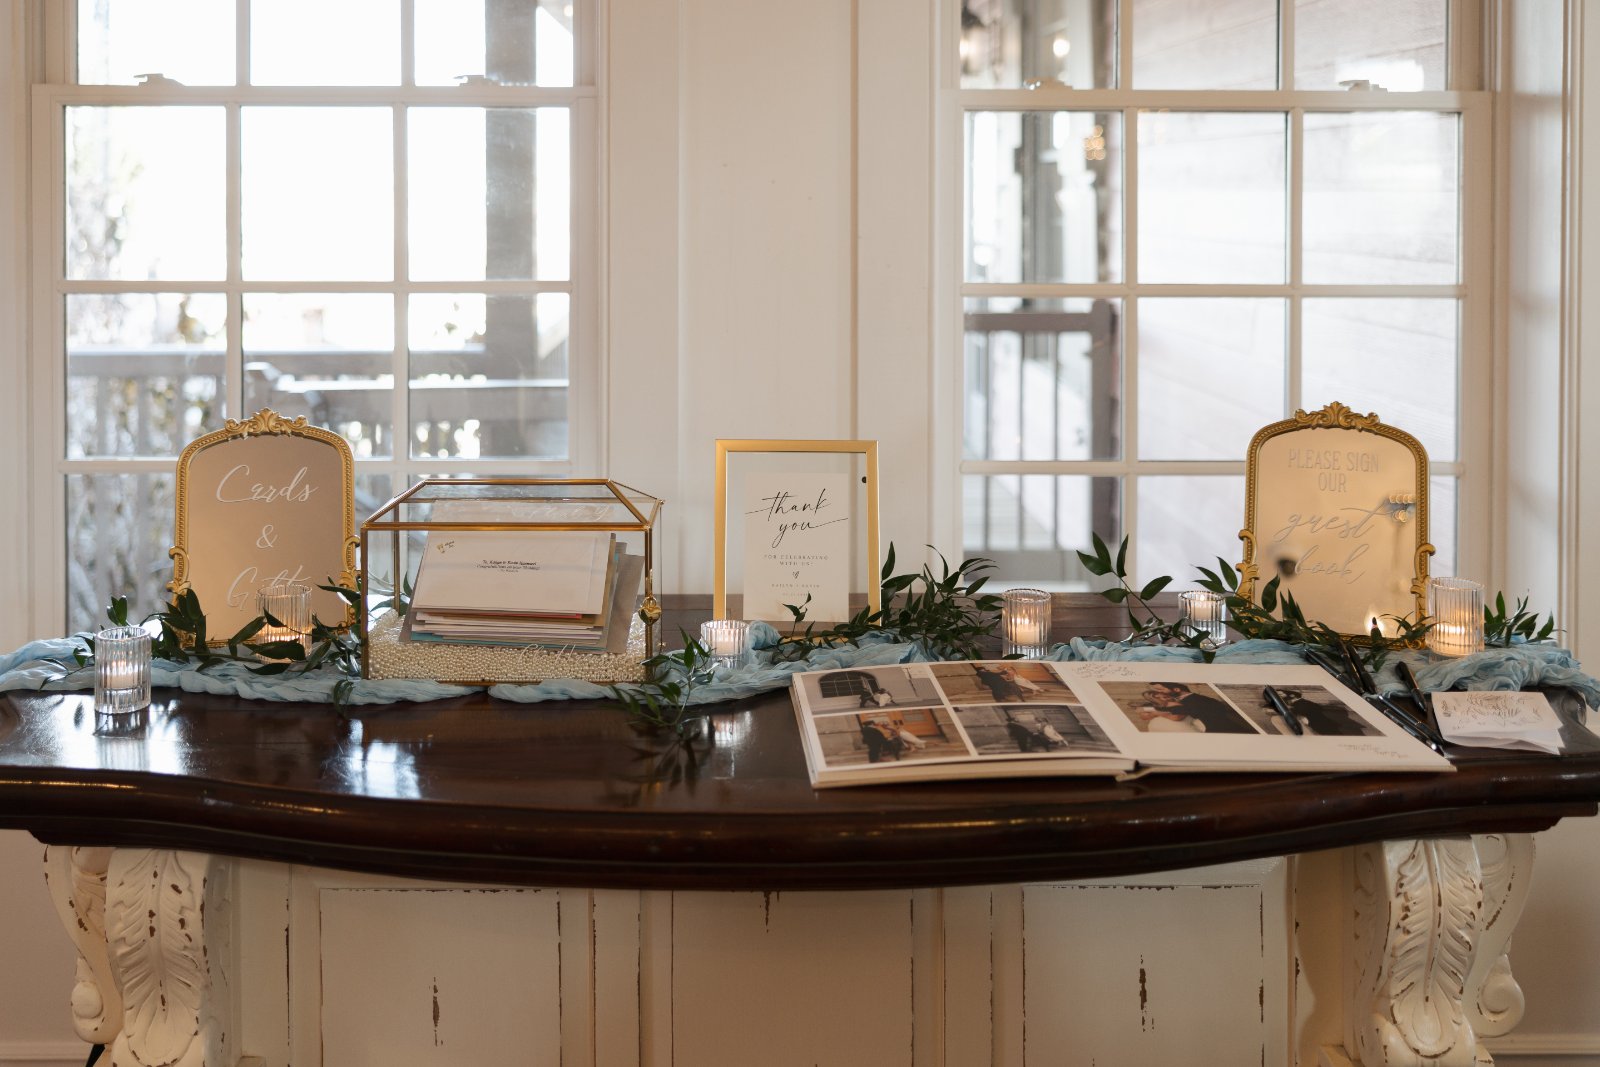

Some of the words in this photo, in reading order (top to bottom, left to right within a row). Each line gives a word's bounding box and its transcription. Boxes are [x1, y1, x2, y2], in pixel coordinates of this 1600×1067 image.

[1287, 448, 1342, 472] PLEASE
[1345, 451, 1380, 473] SIGN
[216, 464, 319, 503] Cards
[1317, 471, 1348, 493] OUR
[744, 487, 832, 522] thank
[1273, 498, 1396, 543] guest
[256, 524, 278, 549] &
[771, 517, 849, 549] you
[1293, 543, 1370, 584] book
